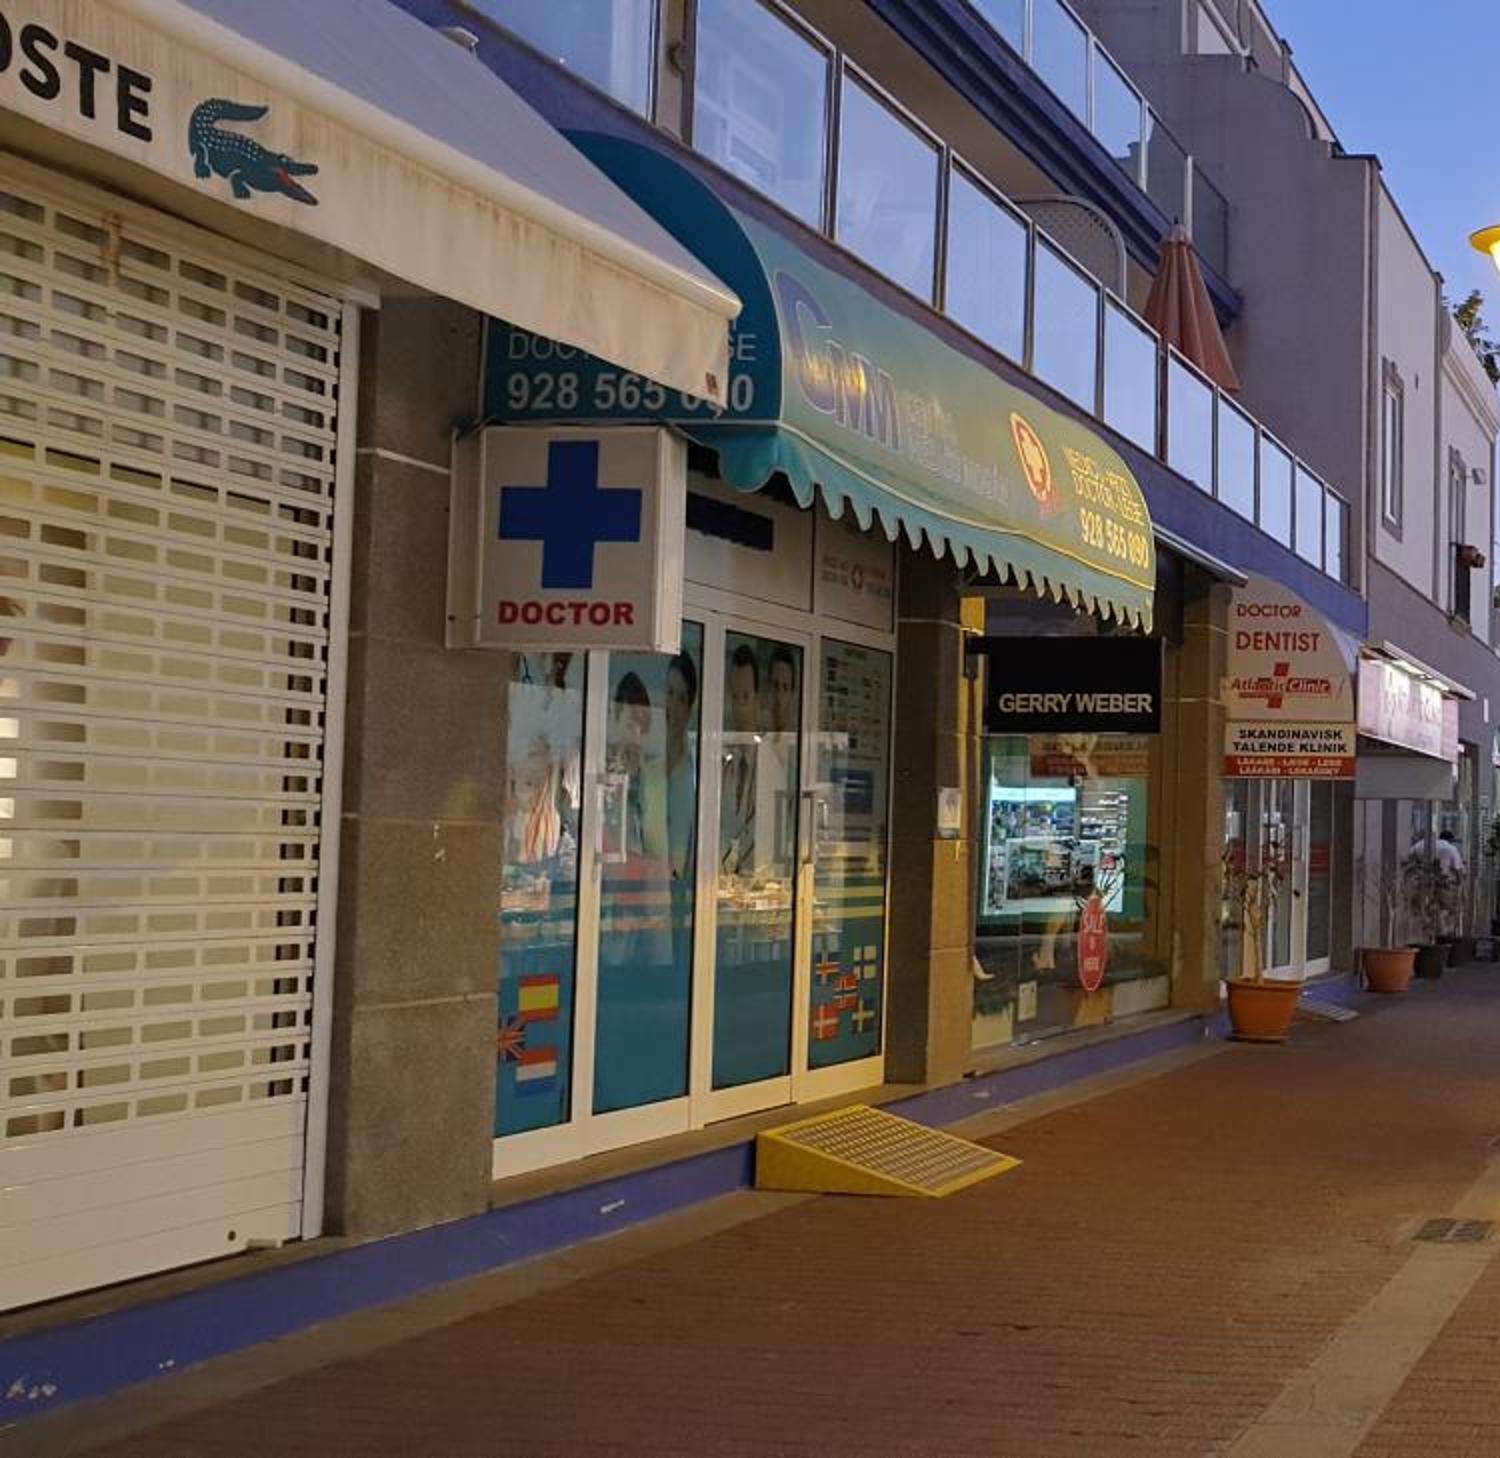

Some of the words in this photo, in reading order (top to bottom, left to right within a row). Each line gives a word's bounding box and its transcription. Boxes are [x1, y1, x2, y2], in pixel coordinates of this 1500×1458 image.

[508, 371, 579, 410] 928
[594, 372, 667, 411] 565
[1080, 507, 1105, 549] 928
[1105, 519, 1128, 559] 565
[498, 601, 635, 626] DOCTOR
[1237, 603, 1301, 618] DOCTOR
[1236, 631, 1320, 652] DENTIST
[1287, 678, 1330, 693] Clinic
[999, 692, 1073, 713] GERRY
[1073, 692, 1153, 713] WEBER
[1238, 729, 1343, 740] SKANDINAVISK
[1232, 741, 1296, 753] TALENDE
[1299, 741, 1347, 753] KLINIK
